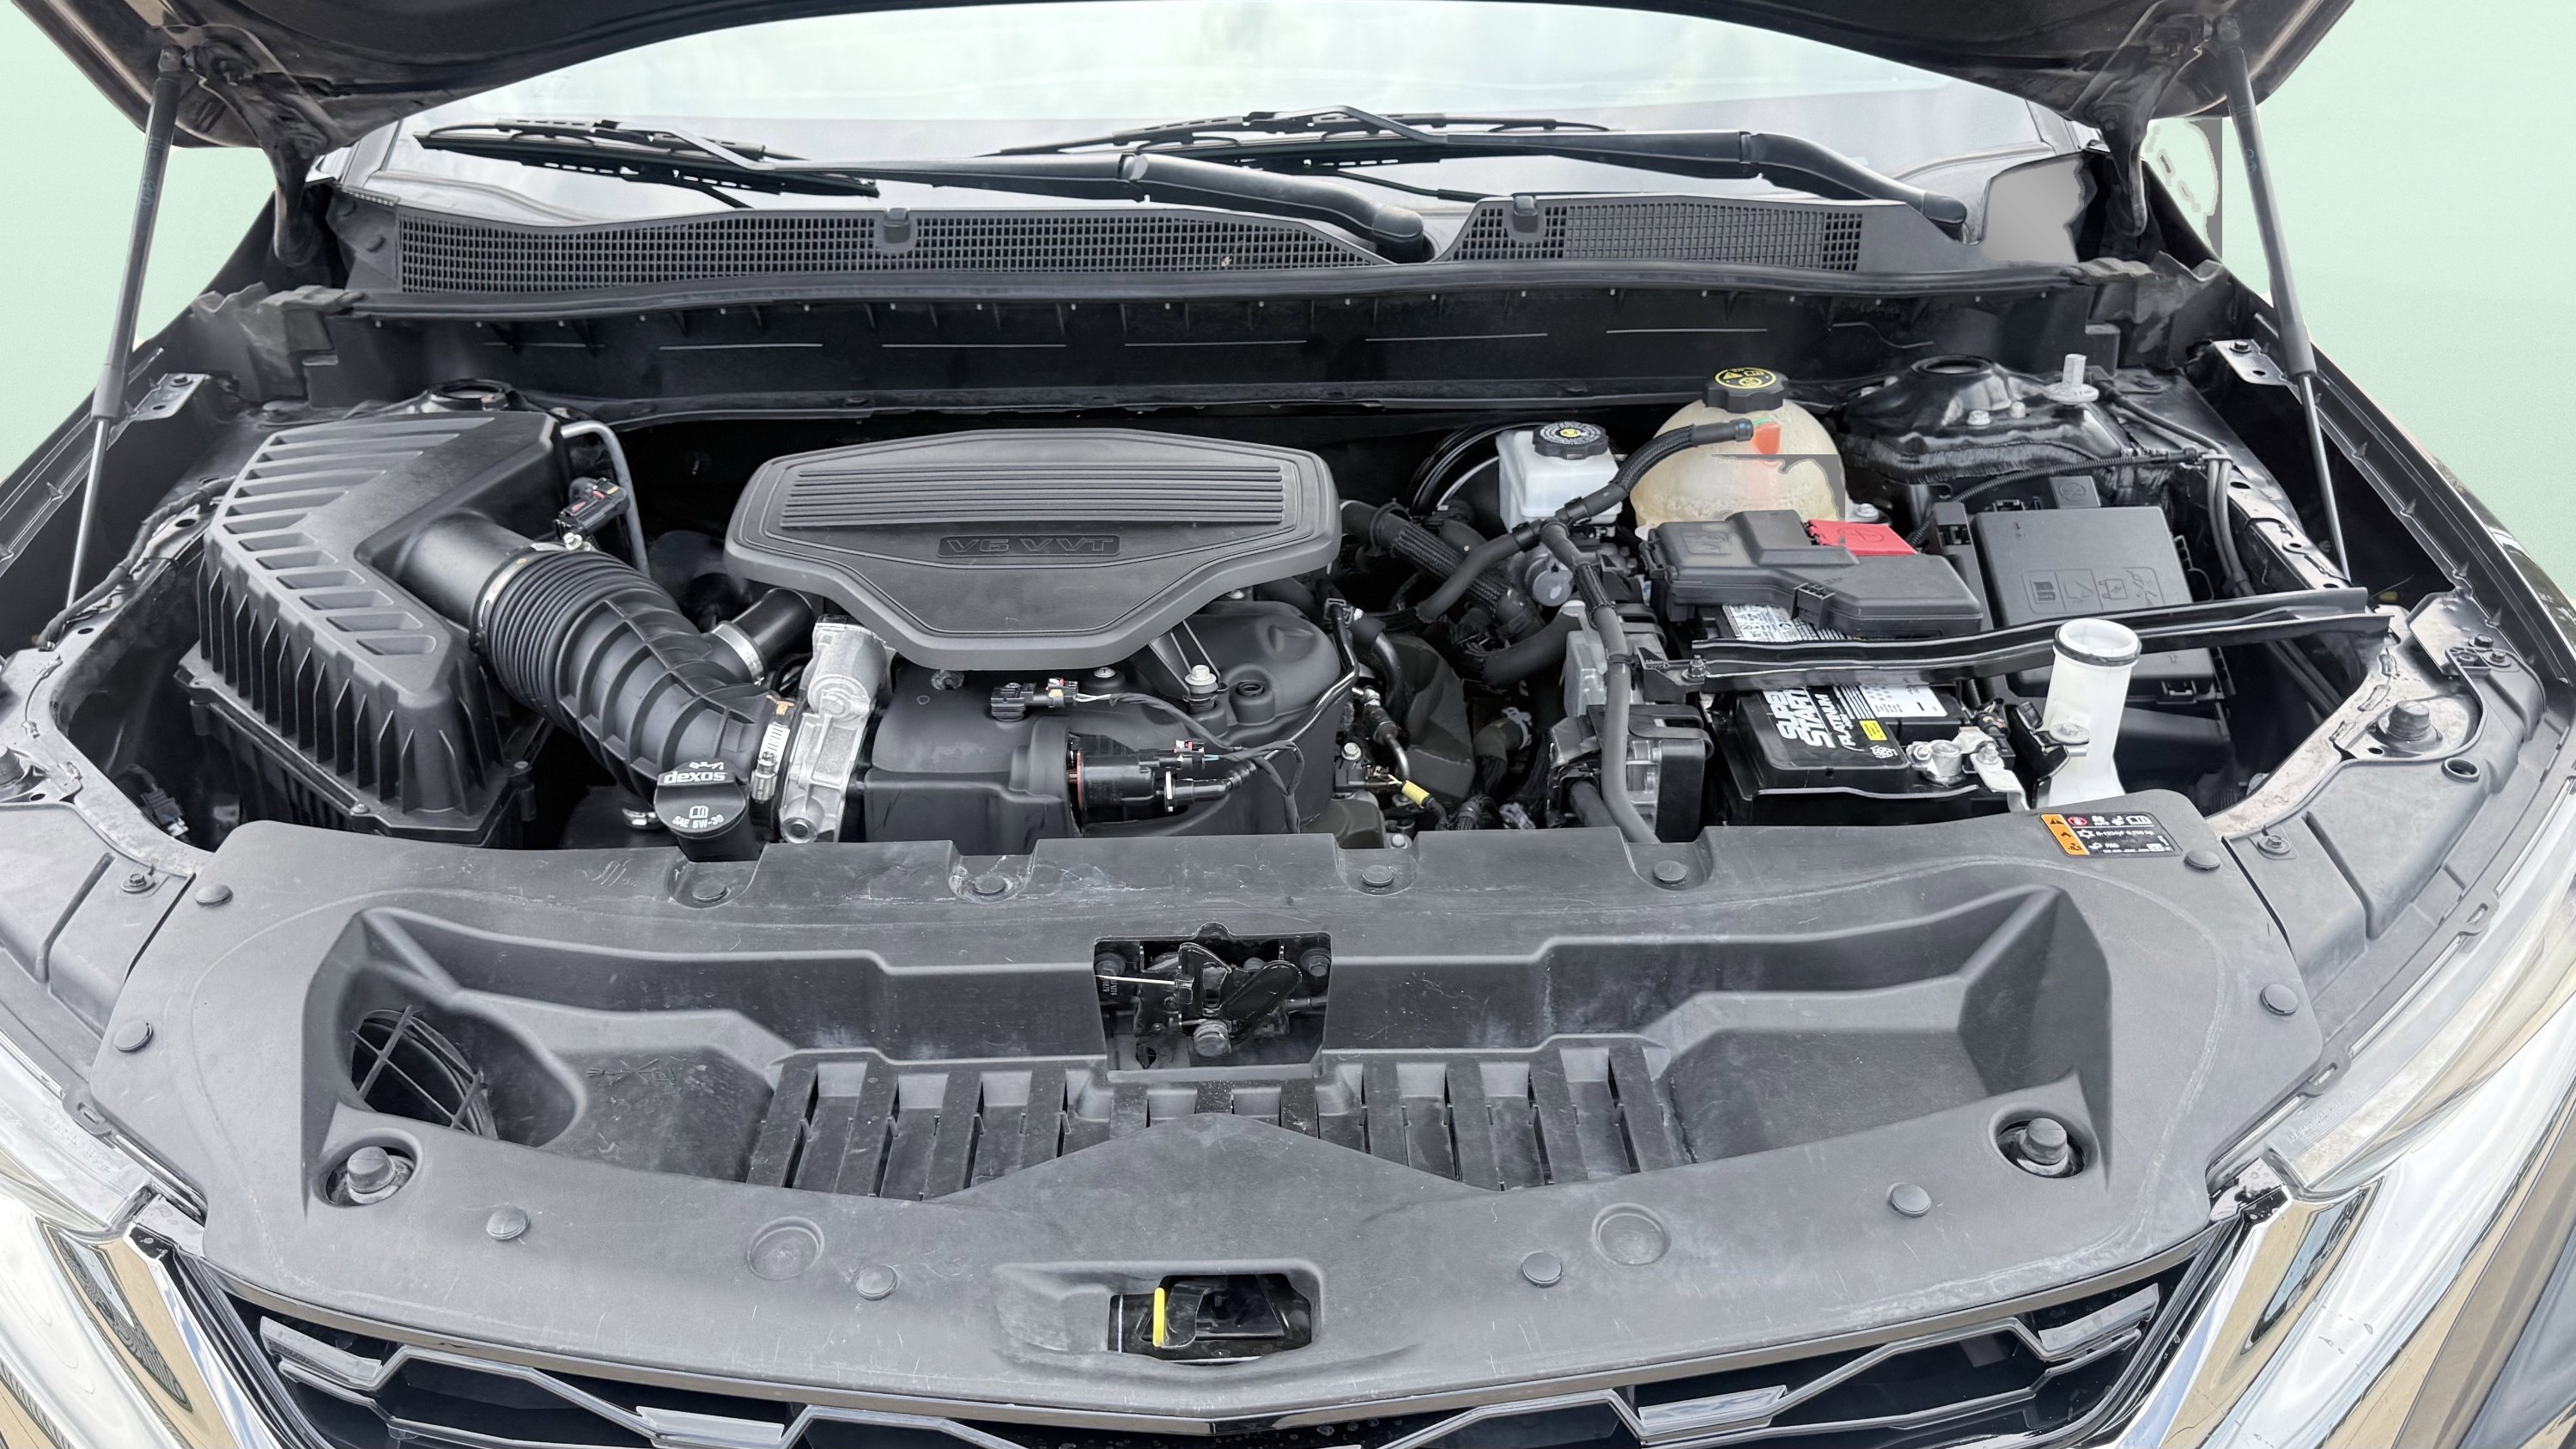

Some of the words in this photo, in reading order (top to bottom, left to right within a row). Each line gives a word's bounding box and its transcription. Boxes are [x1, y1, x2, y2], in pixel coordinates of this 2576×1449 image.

[947, 539, 1009, 553] V6
[1020, 538, 1114, 551] VVT
[1762, 690, 1799, 740] SUPE
[1814, 693, 1856, 746] PLATINUM
[664, 770, 728, 784] dexos
[672, 815, 690, 828] SAE
[692, 813, 724, 829] 5W-30
